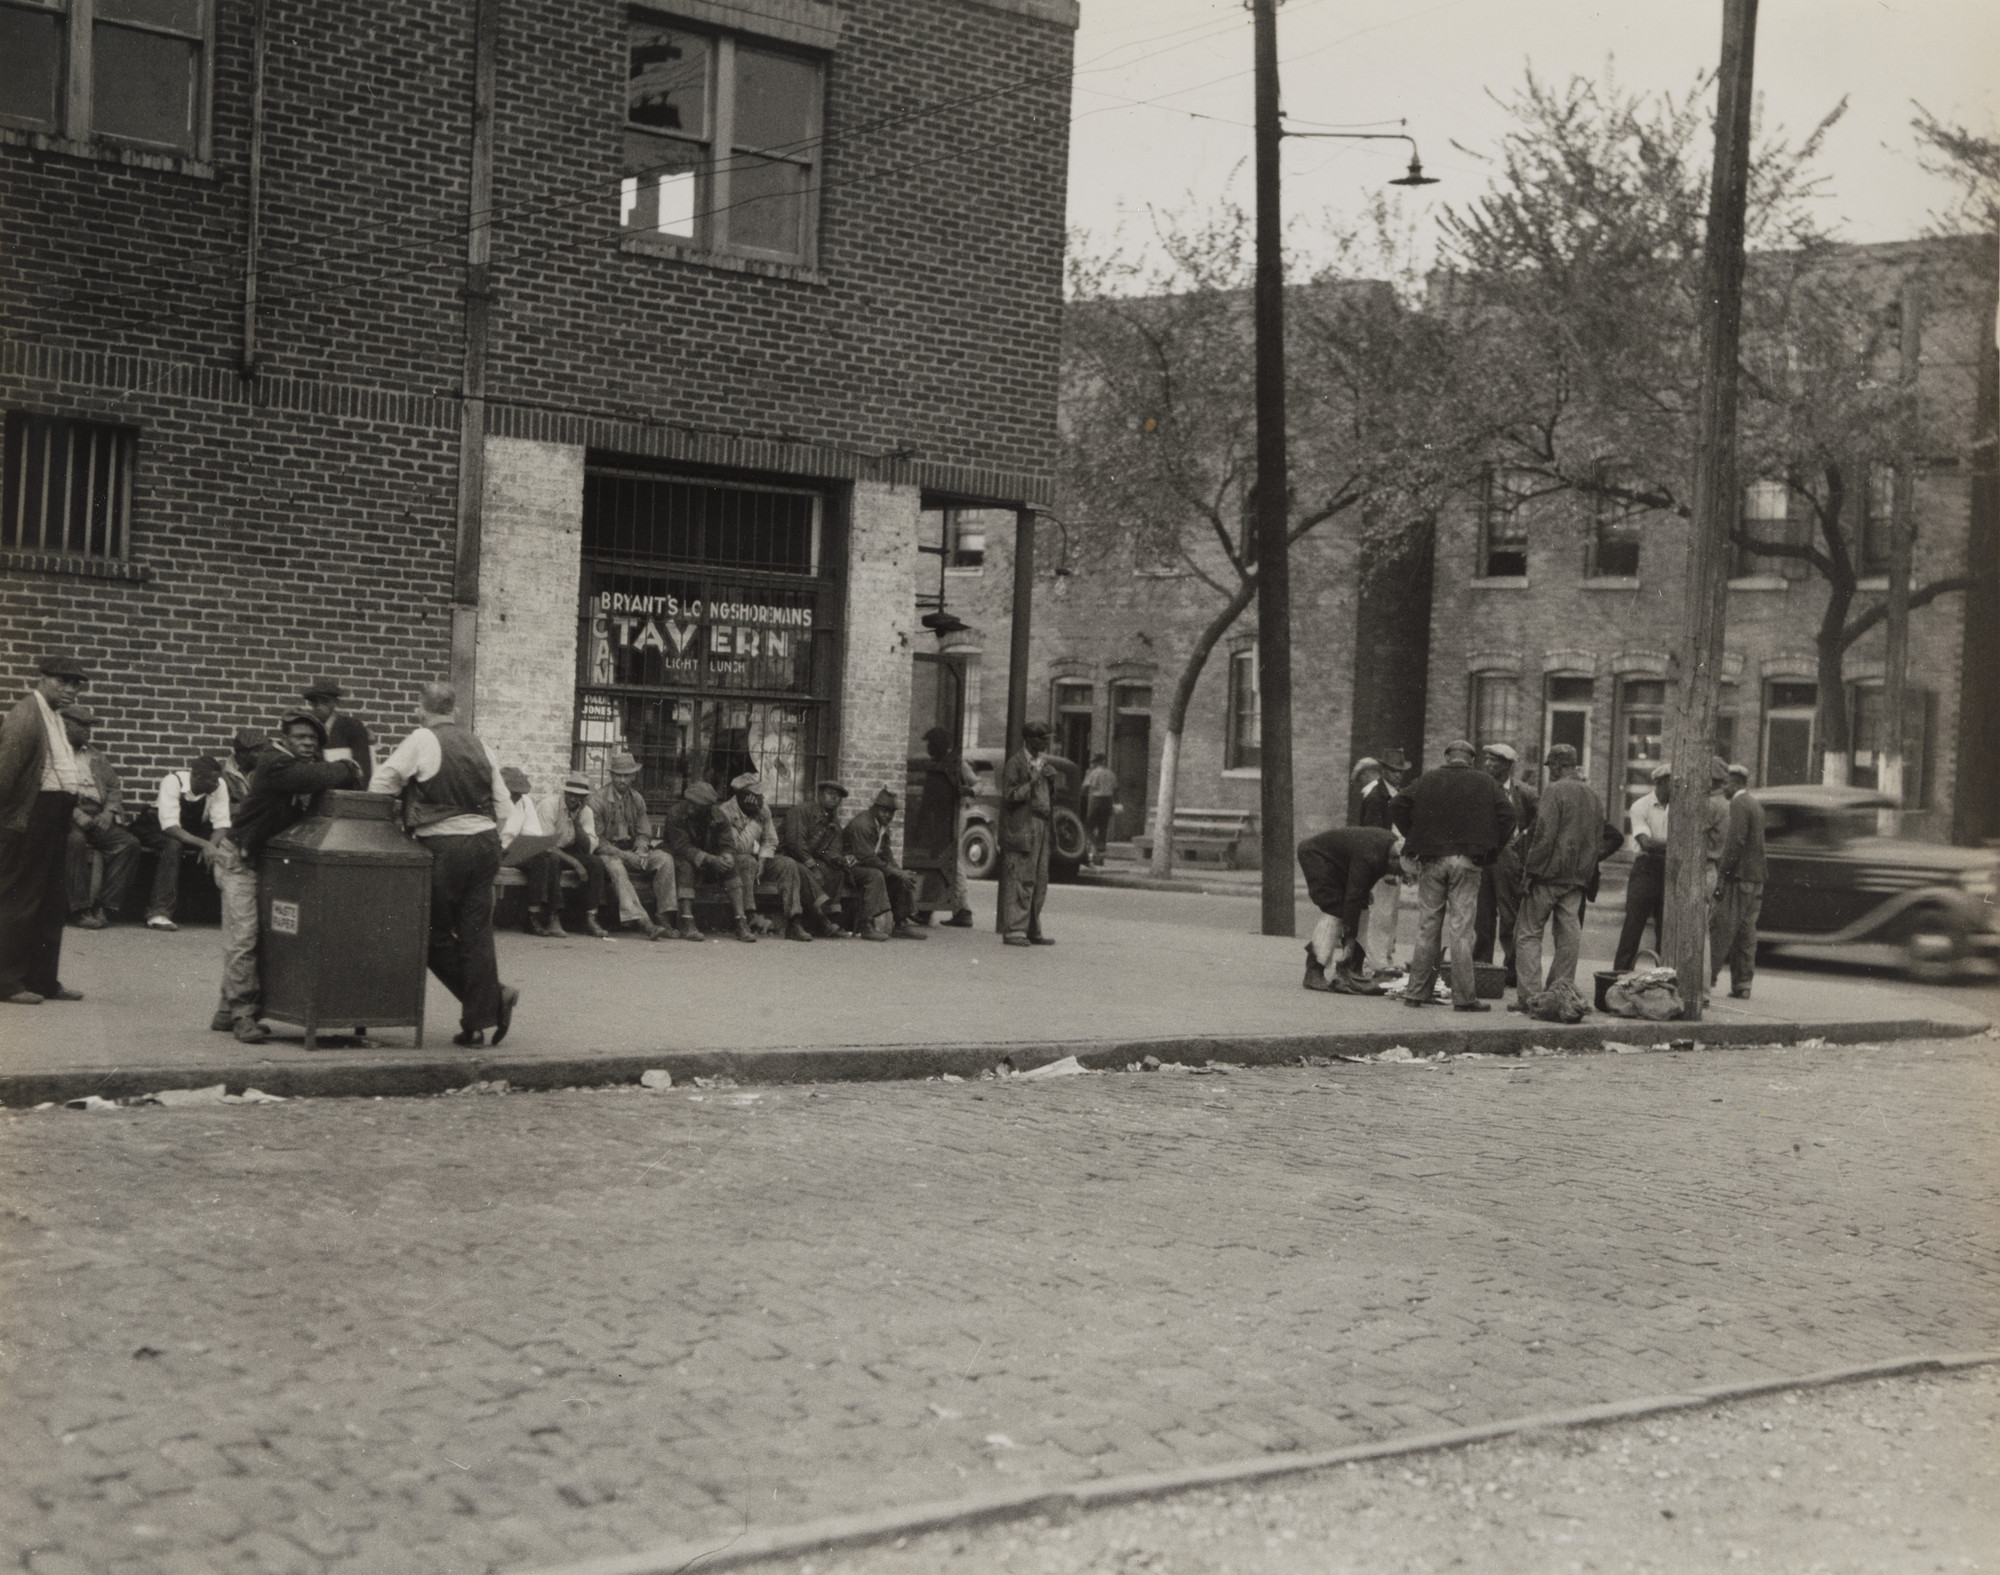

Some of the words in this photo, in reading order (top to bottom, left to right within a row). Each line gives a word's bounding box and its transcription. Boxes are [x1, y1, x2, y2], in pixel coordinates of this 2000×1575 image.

[601, 591, 679, 616] BRYANT'S
[612, 615, 789, 658] TAVERN
[665, 657, 698, 671] LIGHT
[710, 659, 746, 674] LUNCH
[581, 704, 613, 717] JONES
